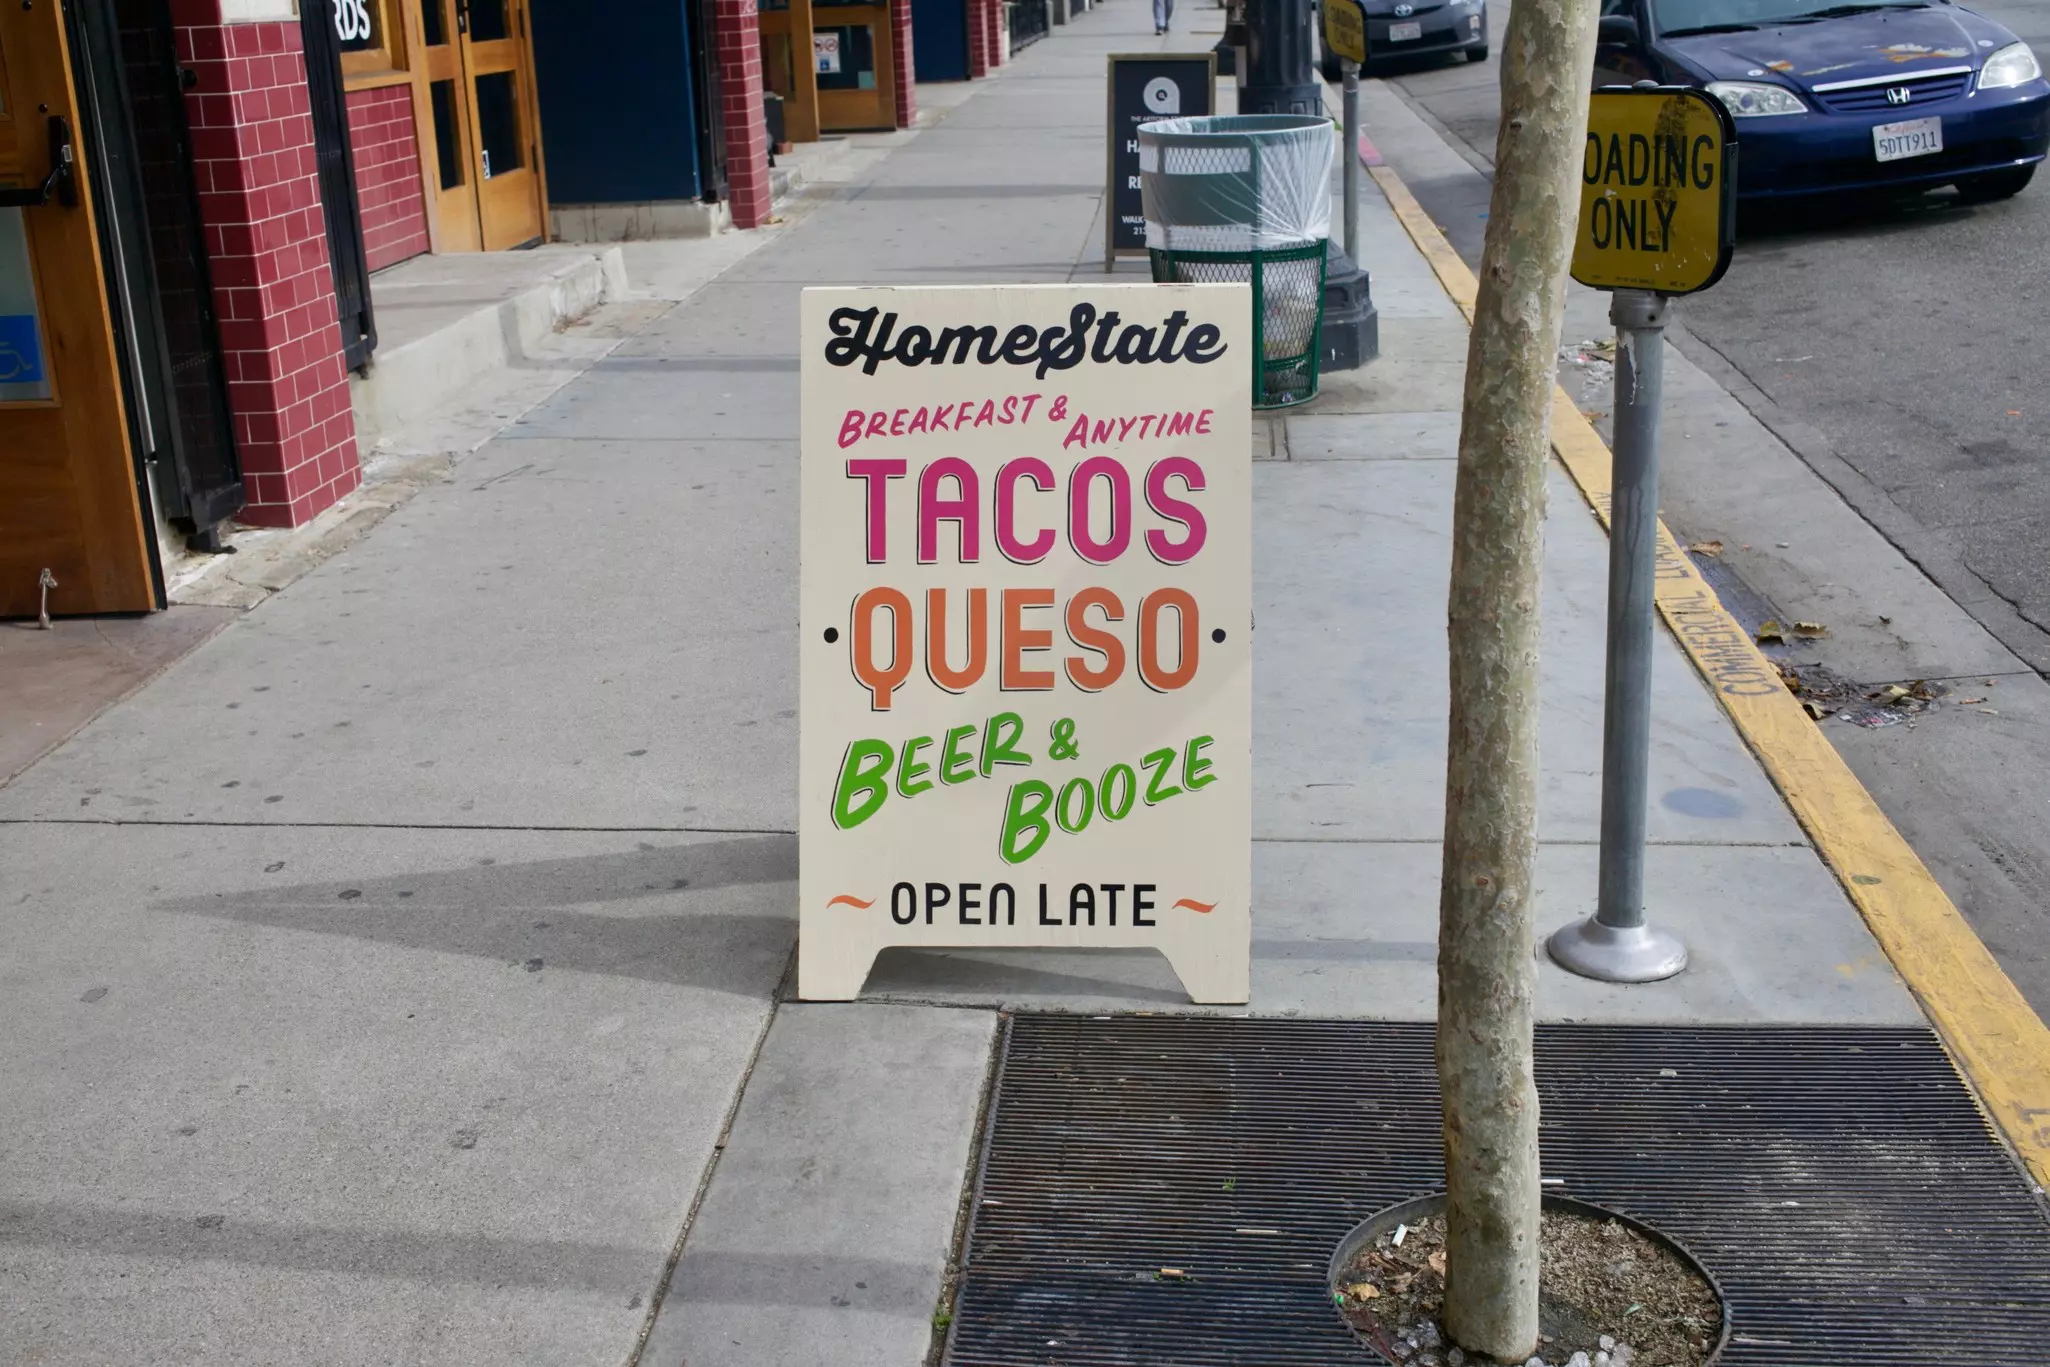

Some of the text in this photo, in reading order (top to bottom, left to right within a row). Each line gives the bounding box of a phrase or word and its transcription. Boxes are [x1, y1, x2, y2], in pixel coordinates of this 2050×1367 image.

[1582, 132, 1714, 190] OADING
[1879, 131, 1938, 155] 5DTT911
[1591, 197, 1677, 252] ONLY
[825, 302, 1228, 380] HomeState
[837, 393, 1214, 449] BREAKFAST & ANYTIME
[846, 456, 1207, 566] TACOS
[850, 586, 1200, 712] QUESO
[830, 711, 1219, 865] BEER & BOOZE
[890, 881, 1157, 927] OPEN LATE
